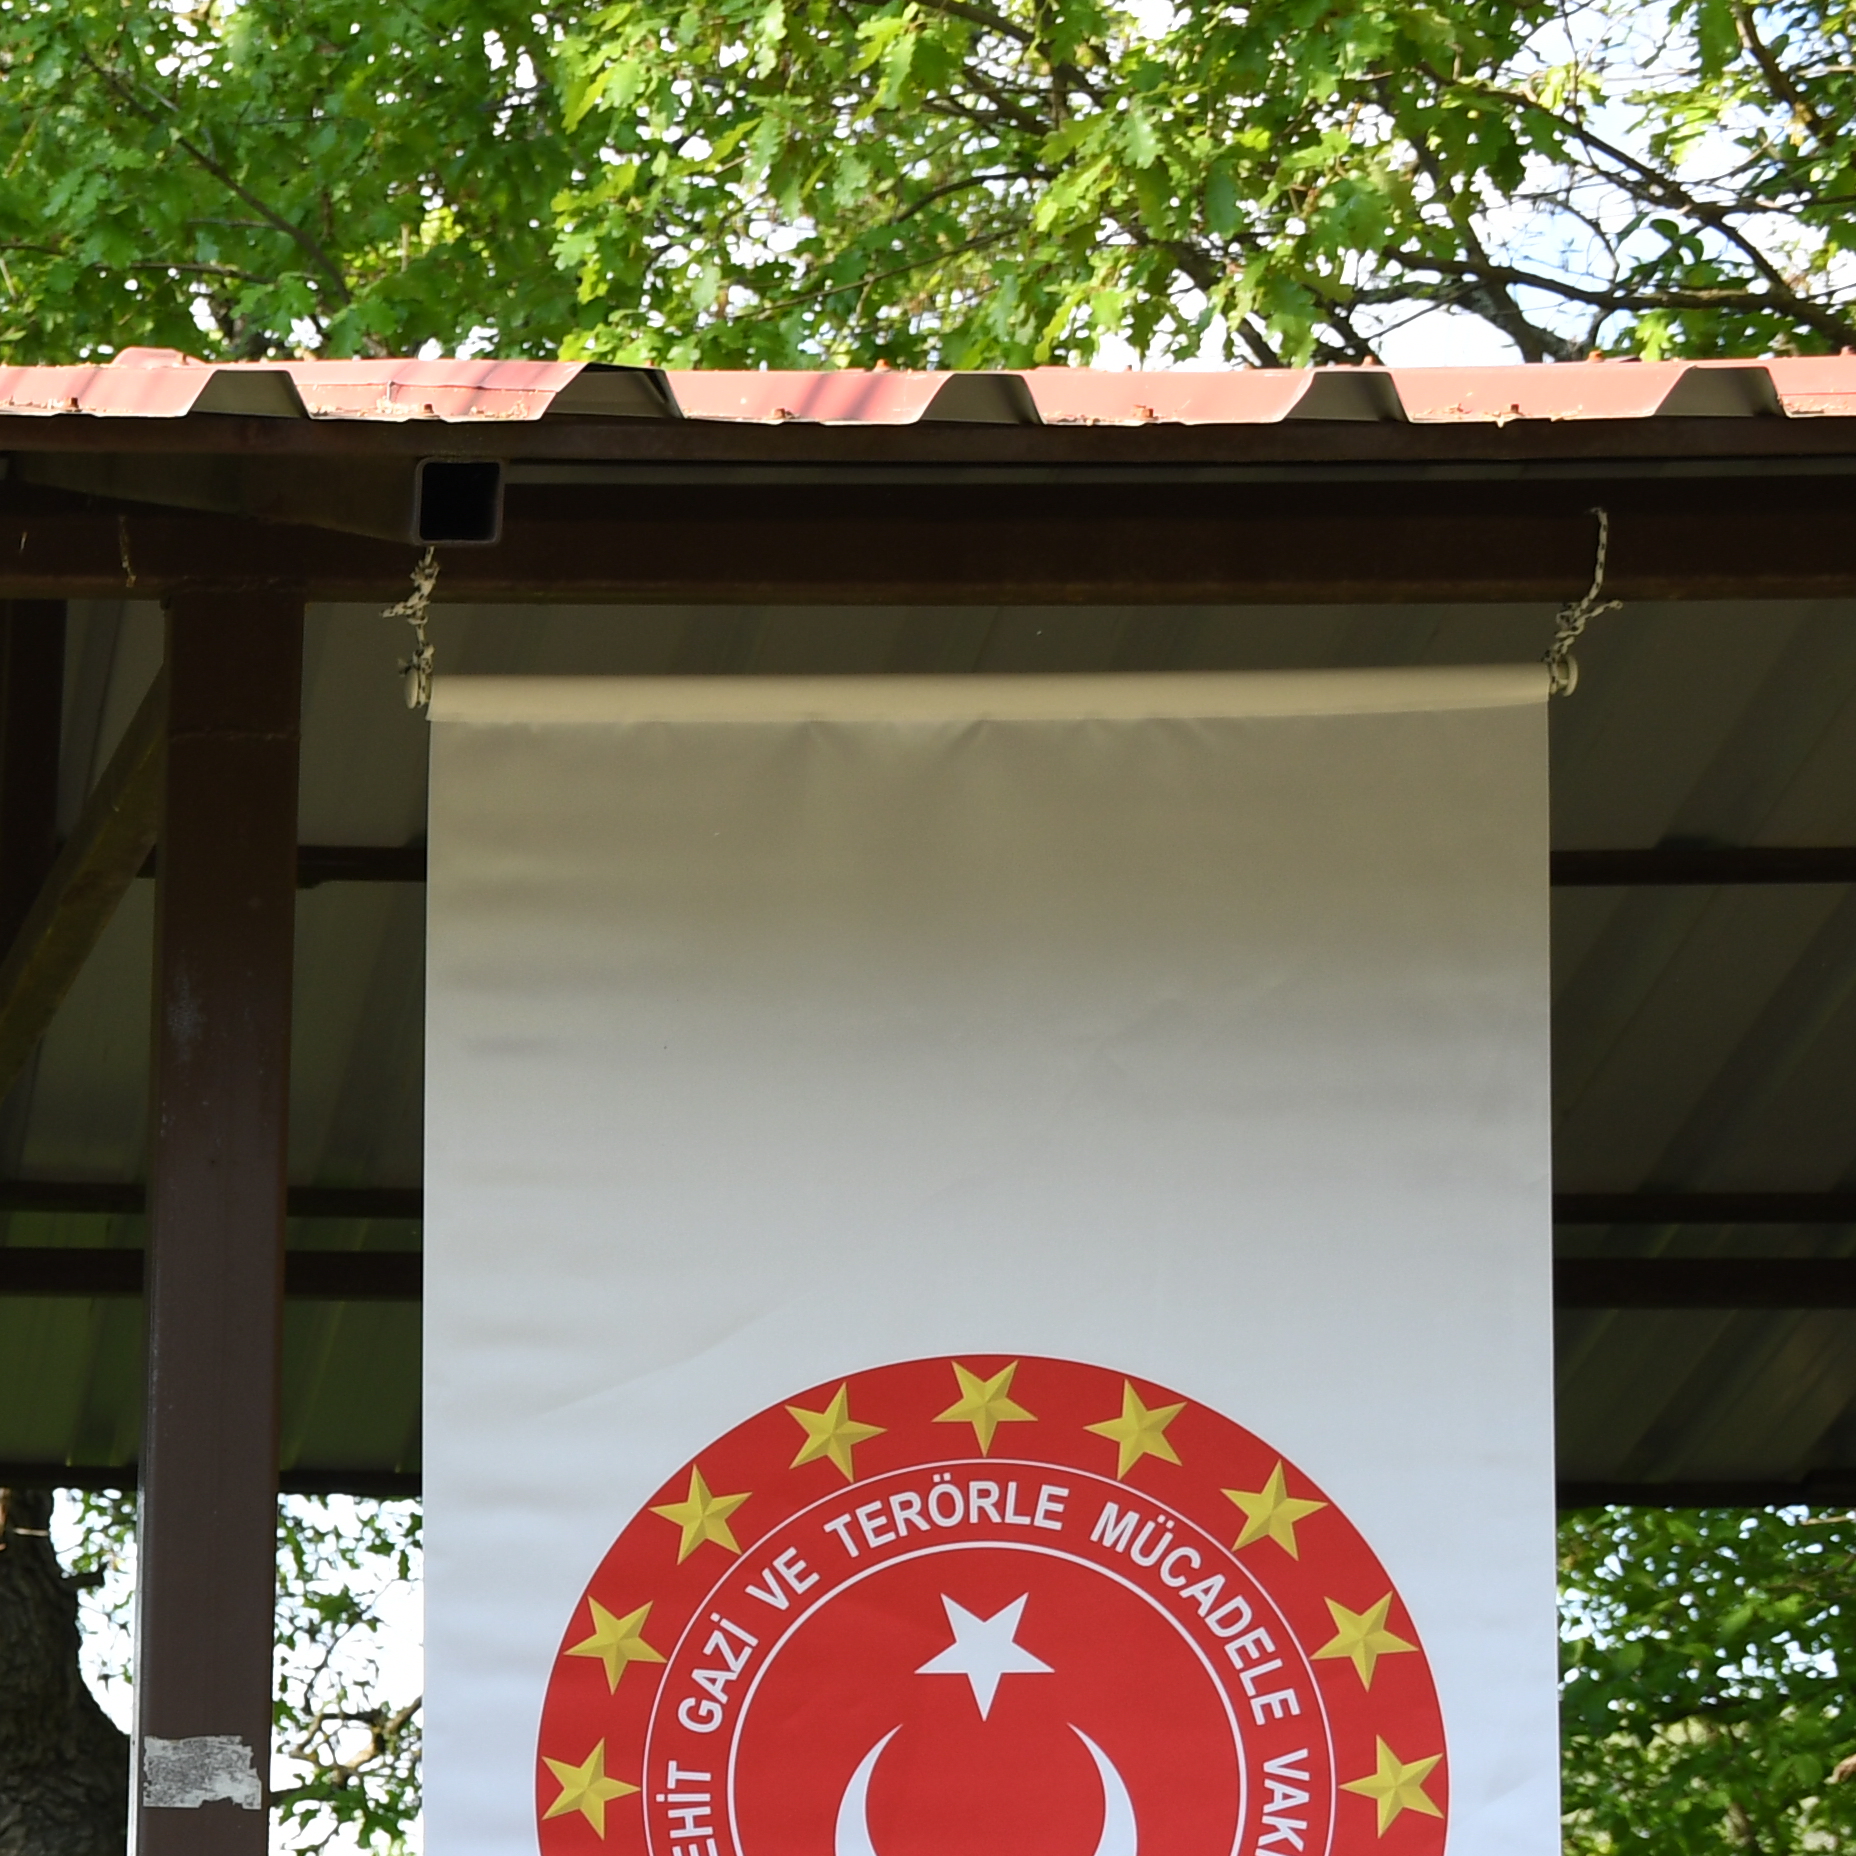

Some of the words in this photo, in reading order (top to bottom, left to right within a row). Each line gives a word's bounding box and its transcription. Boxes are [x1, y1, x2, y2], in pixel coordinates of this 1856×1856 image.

[677, 1612, 760, 1733] GAZİ
[745, 1546, 820, 1611] VE
[823, 1472, 1070, 1558] TERÖRLE
[1090, 1500, 1301, 1726] MÜCADELE
